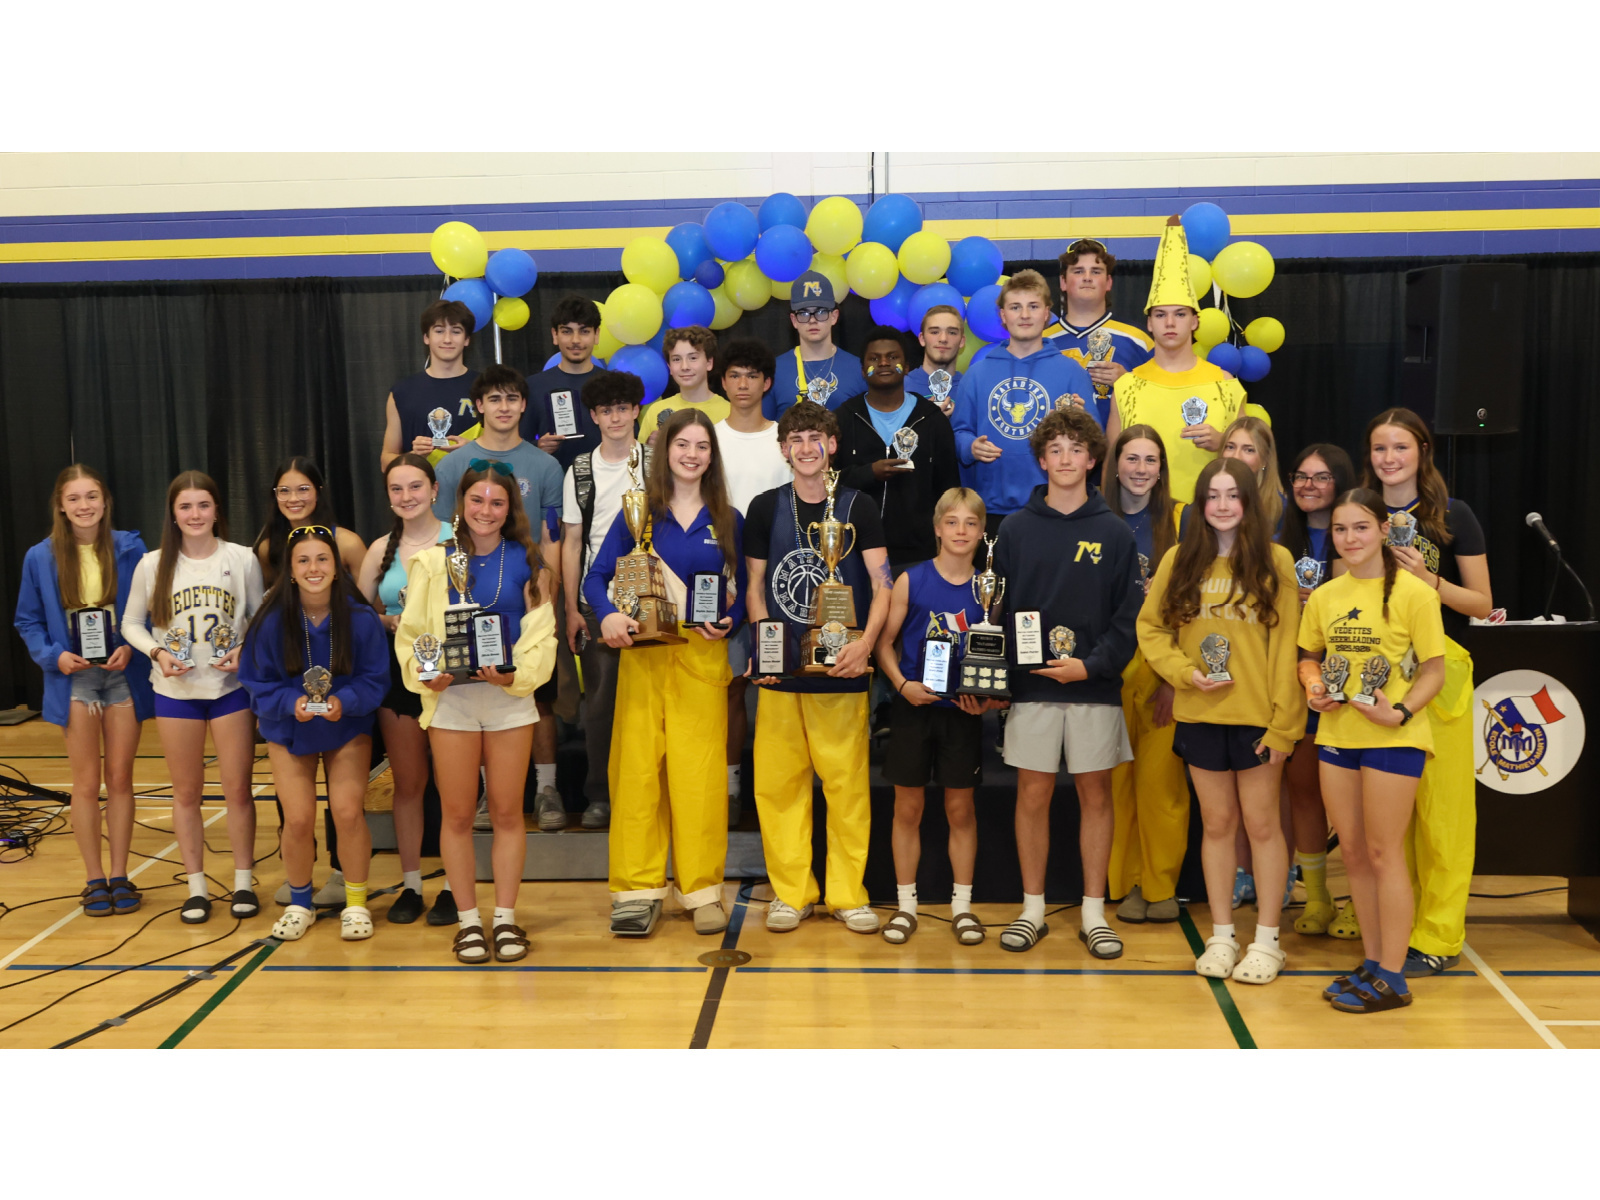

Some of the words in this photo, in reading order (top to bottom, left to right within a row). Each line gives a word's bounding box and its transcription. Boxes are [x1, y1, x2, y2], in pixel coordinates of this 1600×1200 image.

[1074, 541, 1102, 564] M
[171, 586, 235, 619] EDETTES
[188, 613, 219, 643] 12
[1334, 627, 1372, 635] VEDETTES
